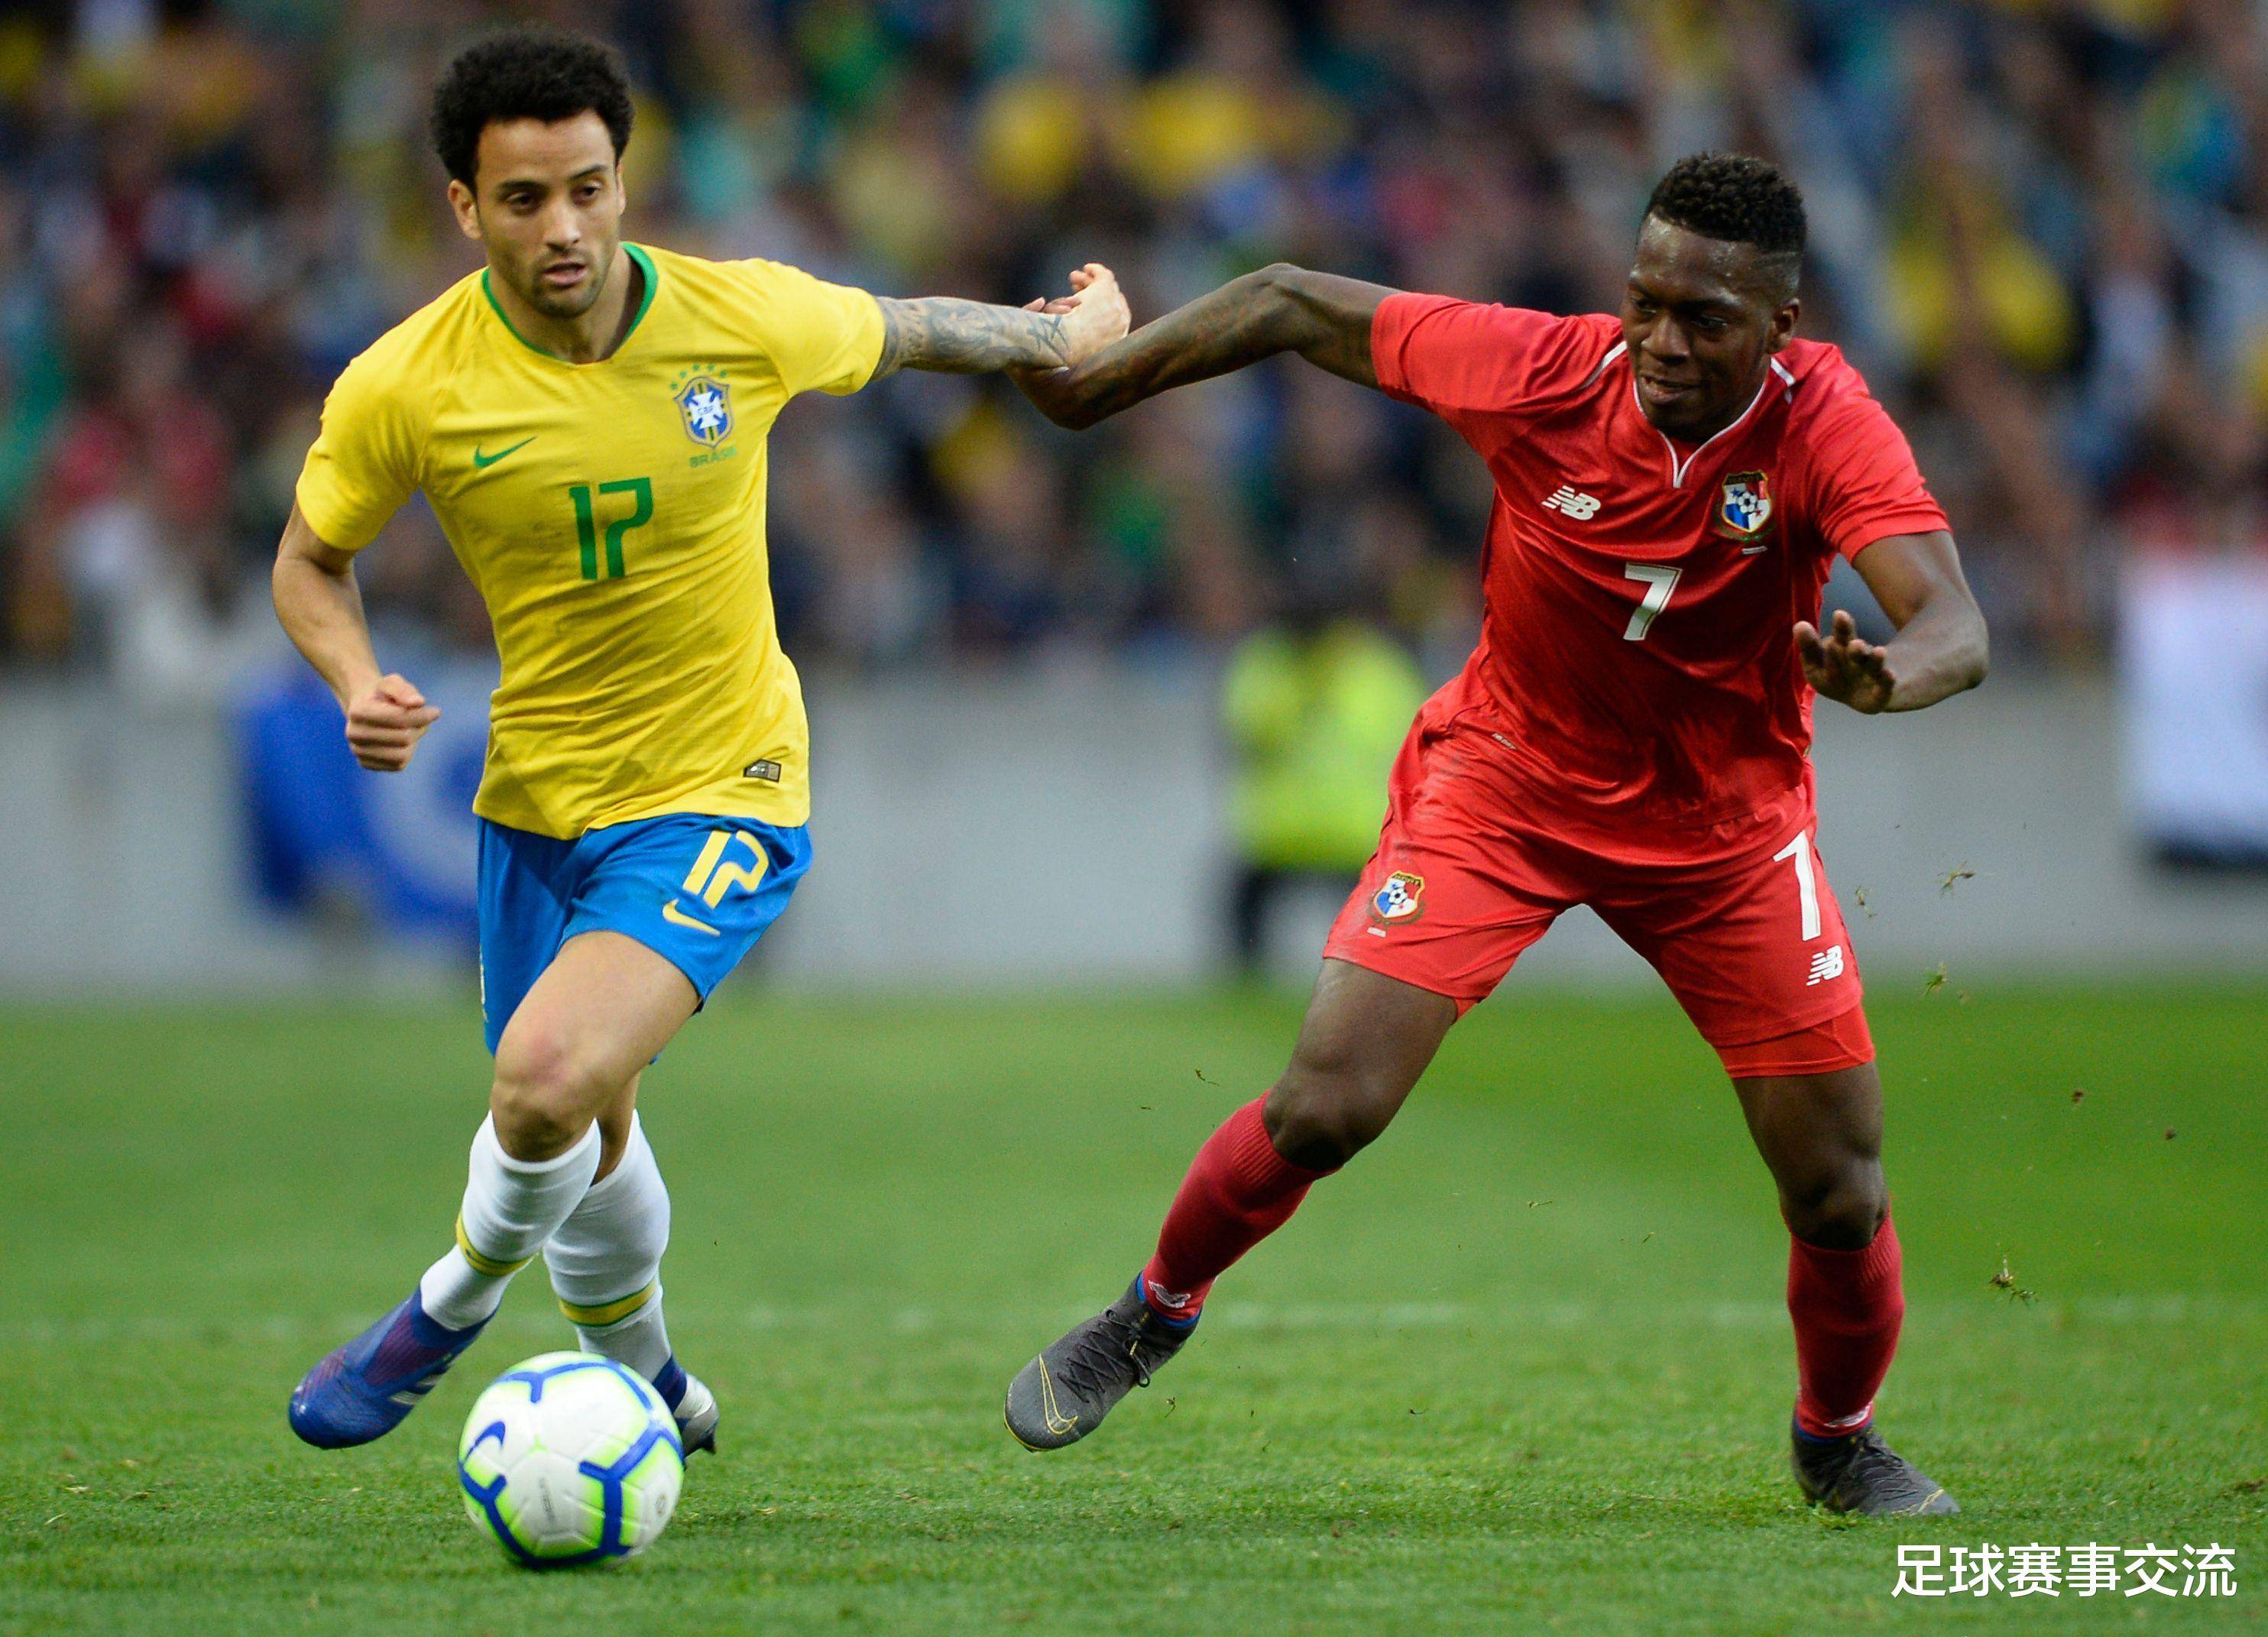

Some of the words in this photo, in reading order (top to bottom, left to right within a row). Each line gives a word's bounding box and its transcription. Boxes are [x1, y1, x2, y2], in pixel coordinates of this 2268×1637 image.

[569, 477, 653, 581] 17
[1623, 562, 1683, 641] 7
[682, 829, 770, 909] 17
[1773, 830, 1821, 942] 7
